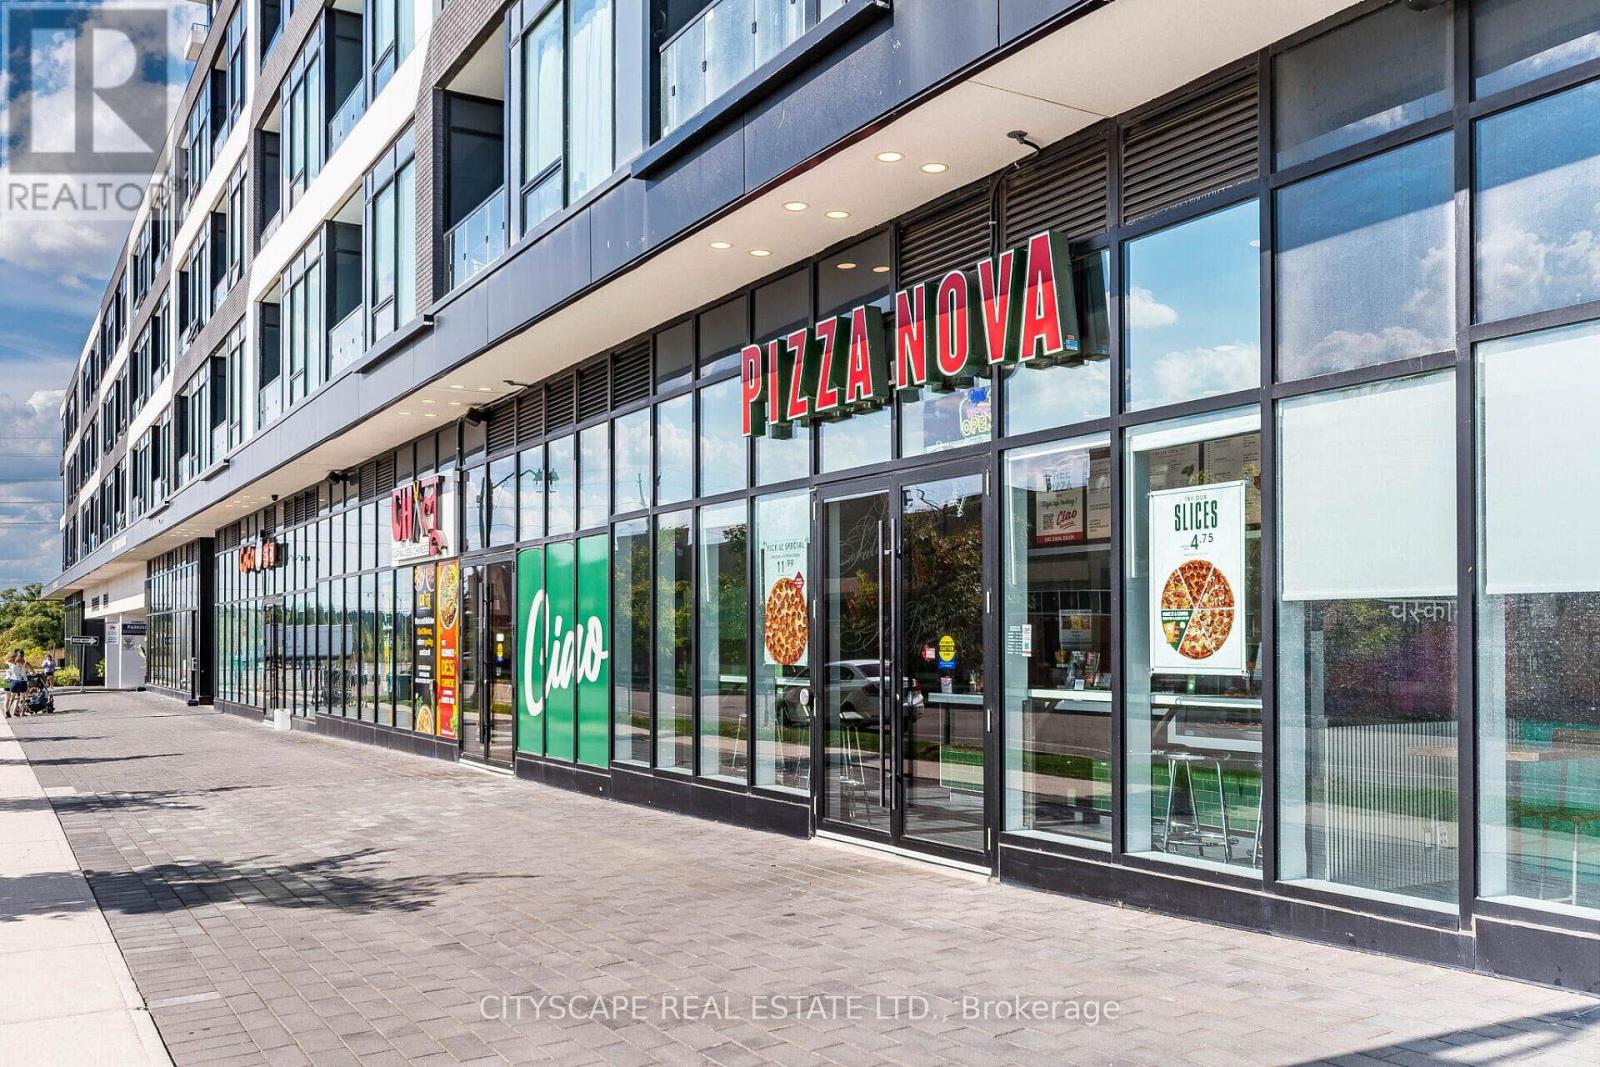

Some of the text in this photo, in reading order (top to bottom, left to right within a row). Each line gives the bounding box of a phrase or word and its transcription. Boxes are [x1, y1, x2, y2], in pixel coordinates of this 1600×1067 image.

[741, 230, 1064, 437] PIZZA NOVA
[1056, 509, 1078, 526] Ciao
[1174, 500, 1218, 532] SLICES
[785, 541, 805, 550] SPECIAL
[1190, 532, 1214, 550] 4.75
[524, 589, 608, 717] Ciao
